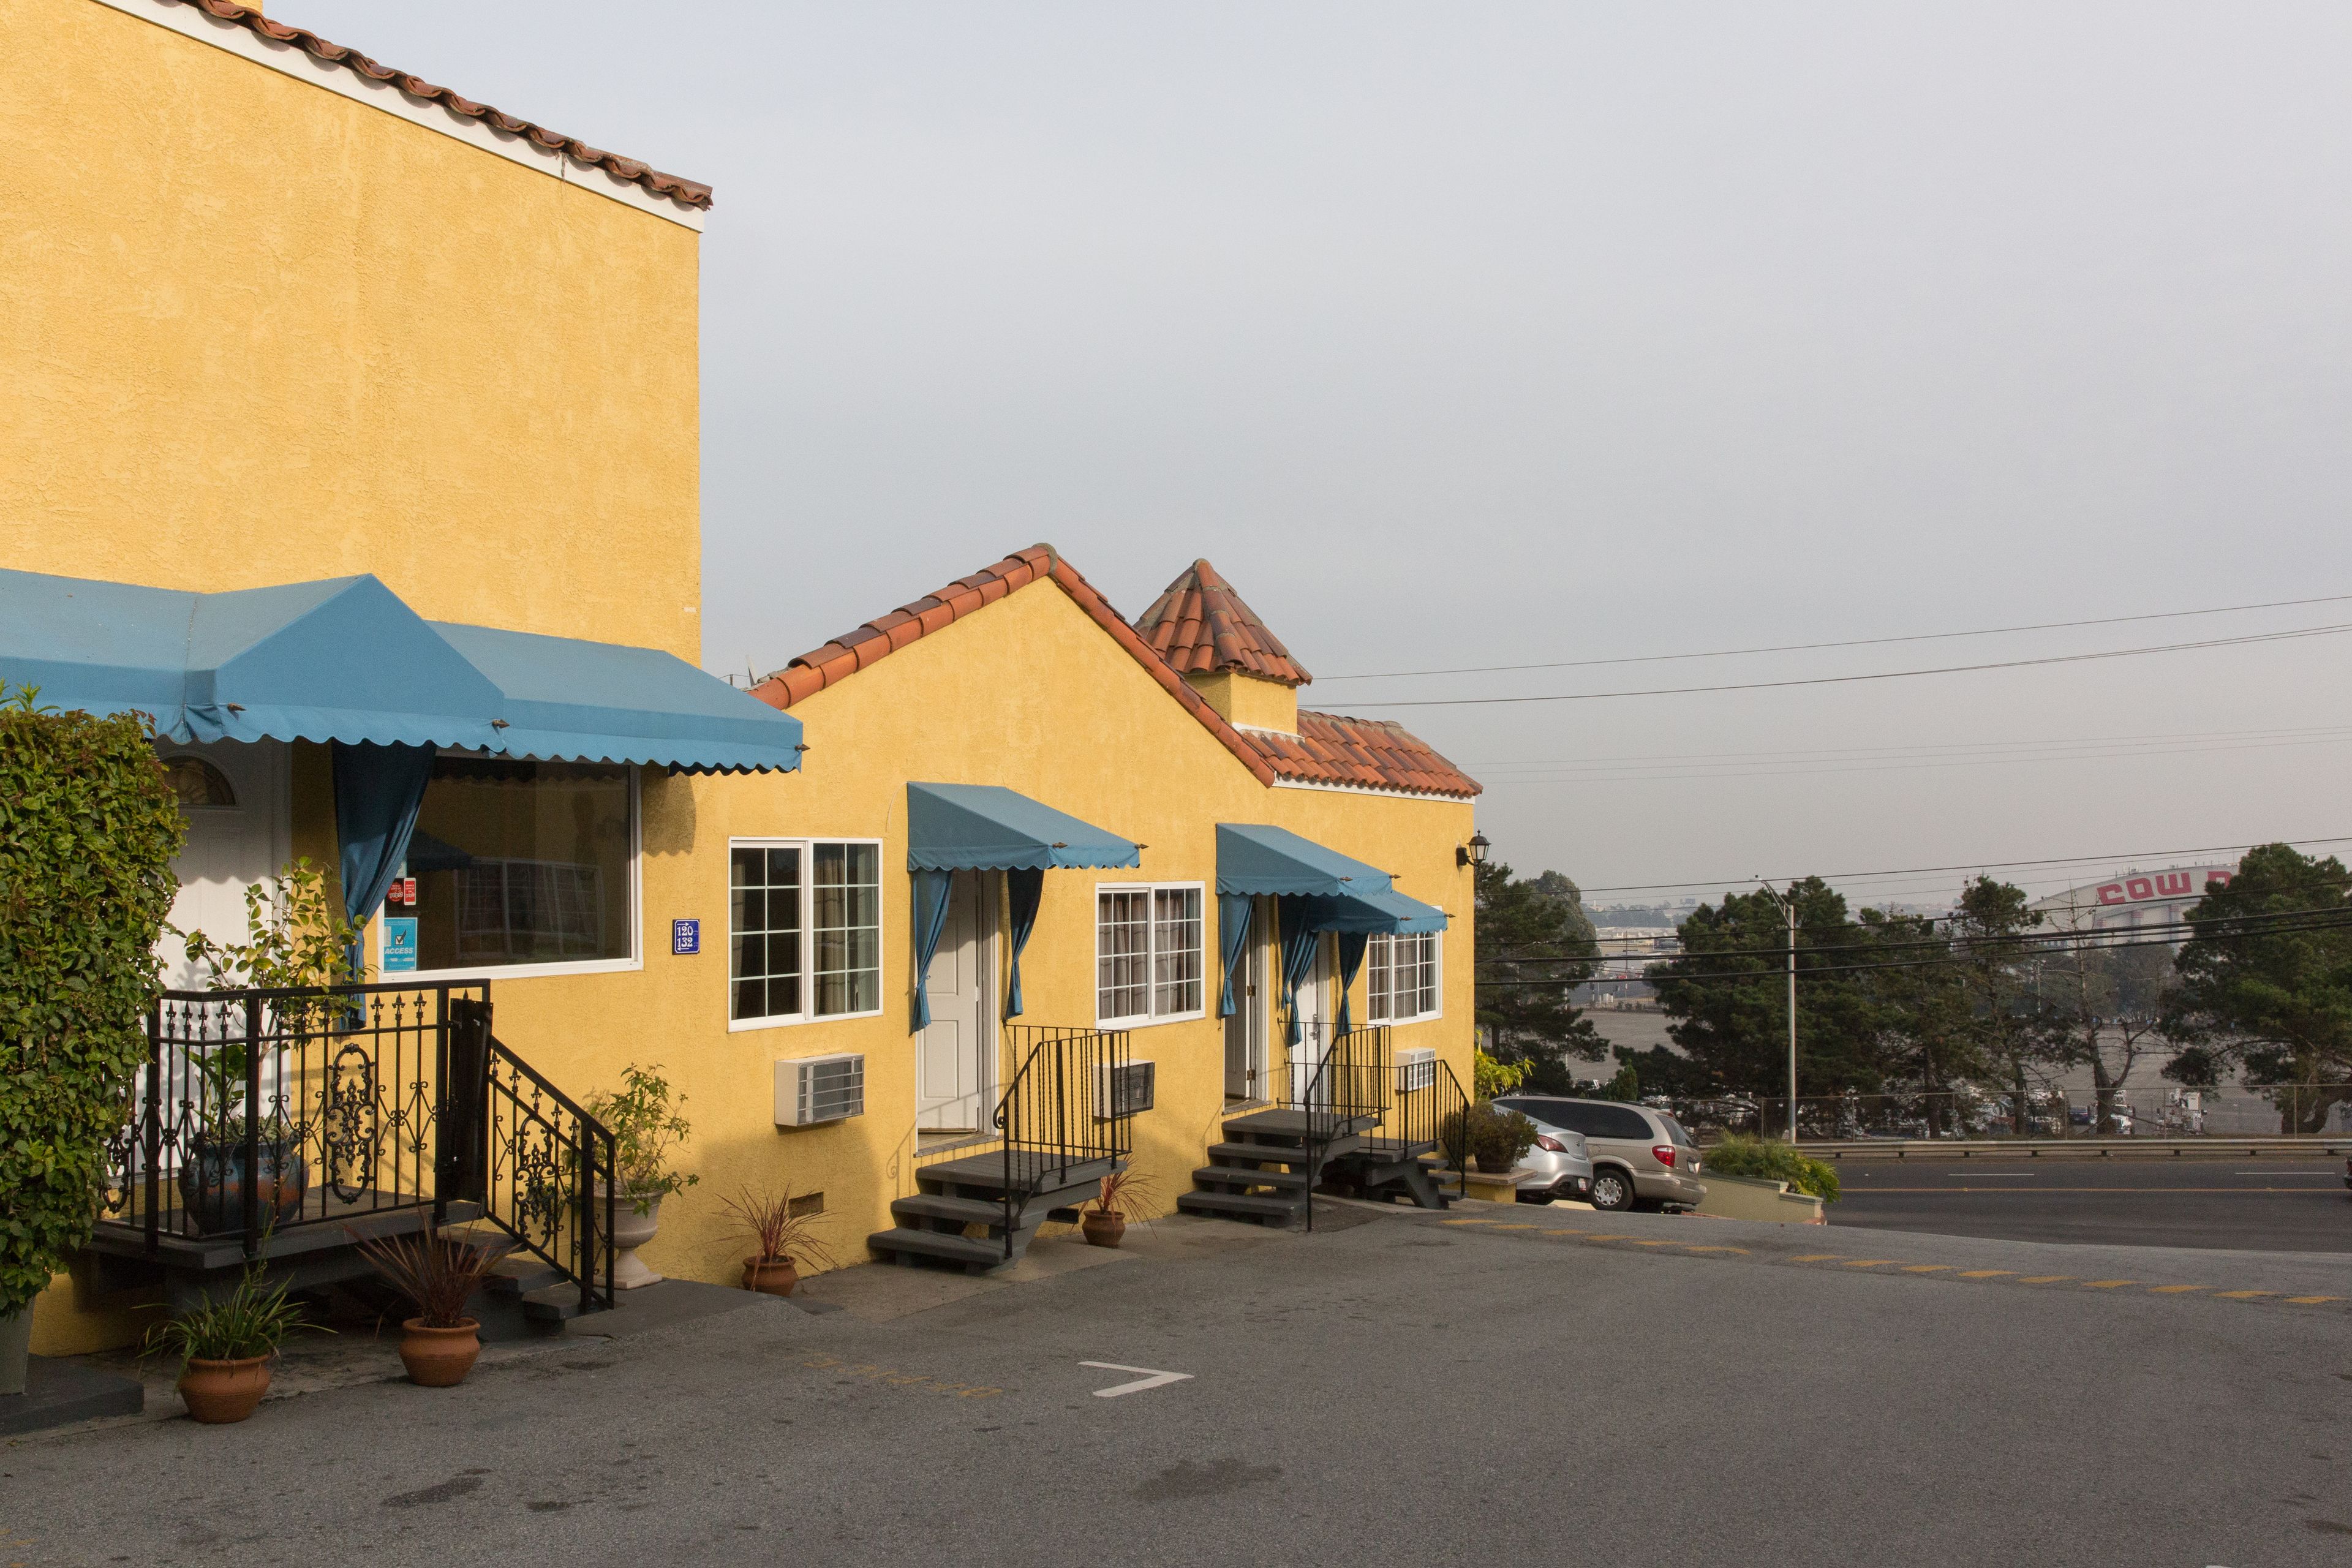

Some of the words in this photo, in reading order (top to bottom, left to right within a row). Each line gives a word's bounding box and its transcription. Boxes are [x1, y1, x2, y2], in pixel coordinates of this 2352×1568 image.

[2097, 872, 2192, 905] COW
[677, 926, 693, 936] 120
[677, 937, 693, 947] 132
